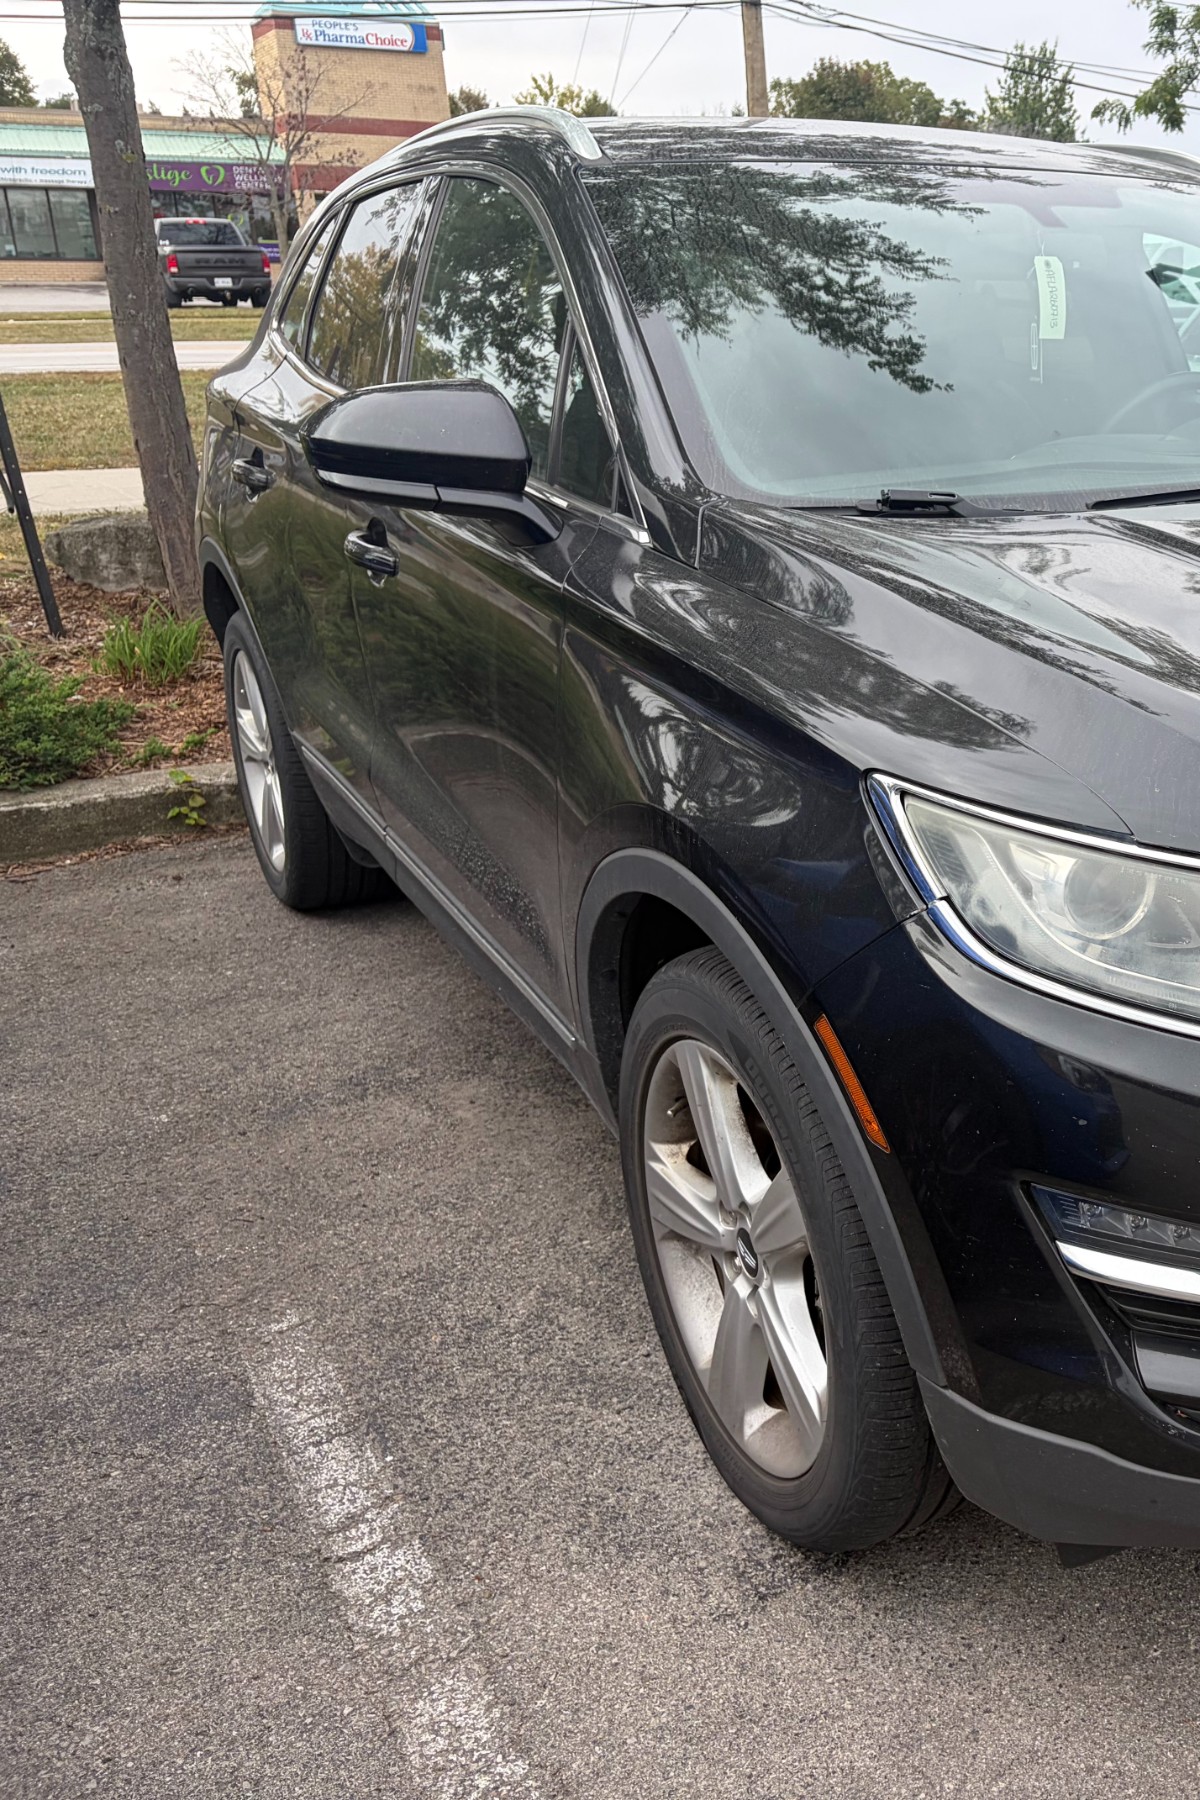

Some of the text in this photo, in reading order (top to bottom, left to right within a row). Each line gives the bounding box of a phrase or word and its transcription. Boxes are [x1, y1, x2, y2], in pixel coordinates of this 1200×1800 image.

[312, 19, 359, 32] PEOPLE'S
[314, 29, 408, 47] PharmaChoice
[0, 166, 86, 176] with freedom
